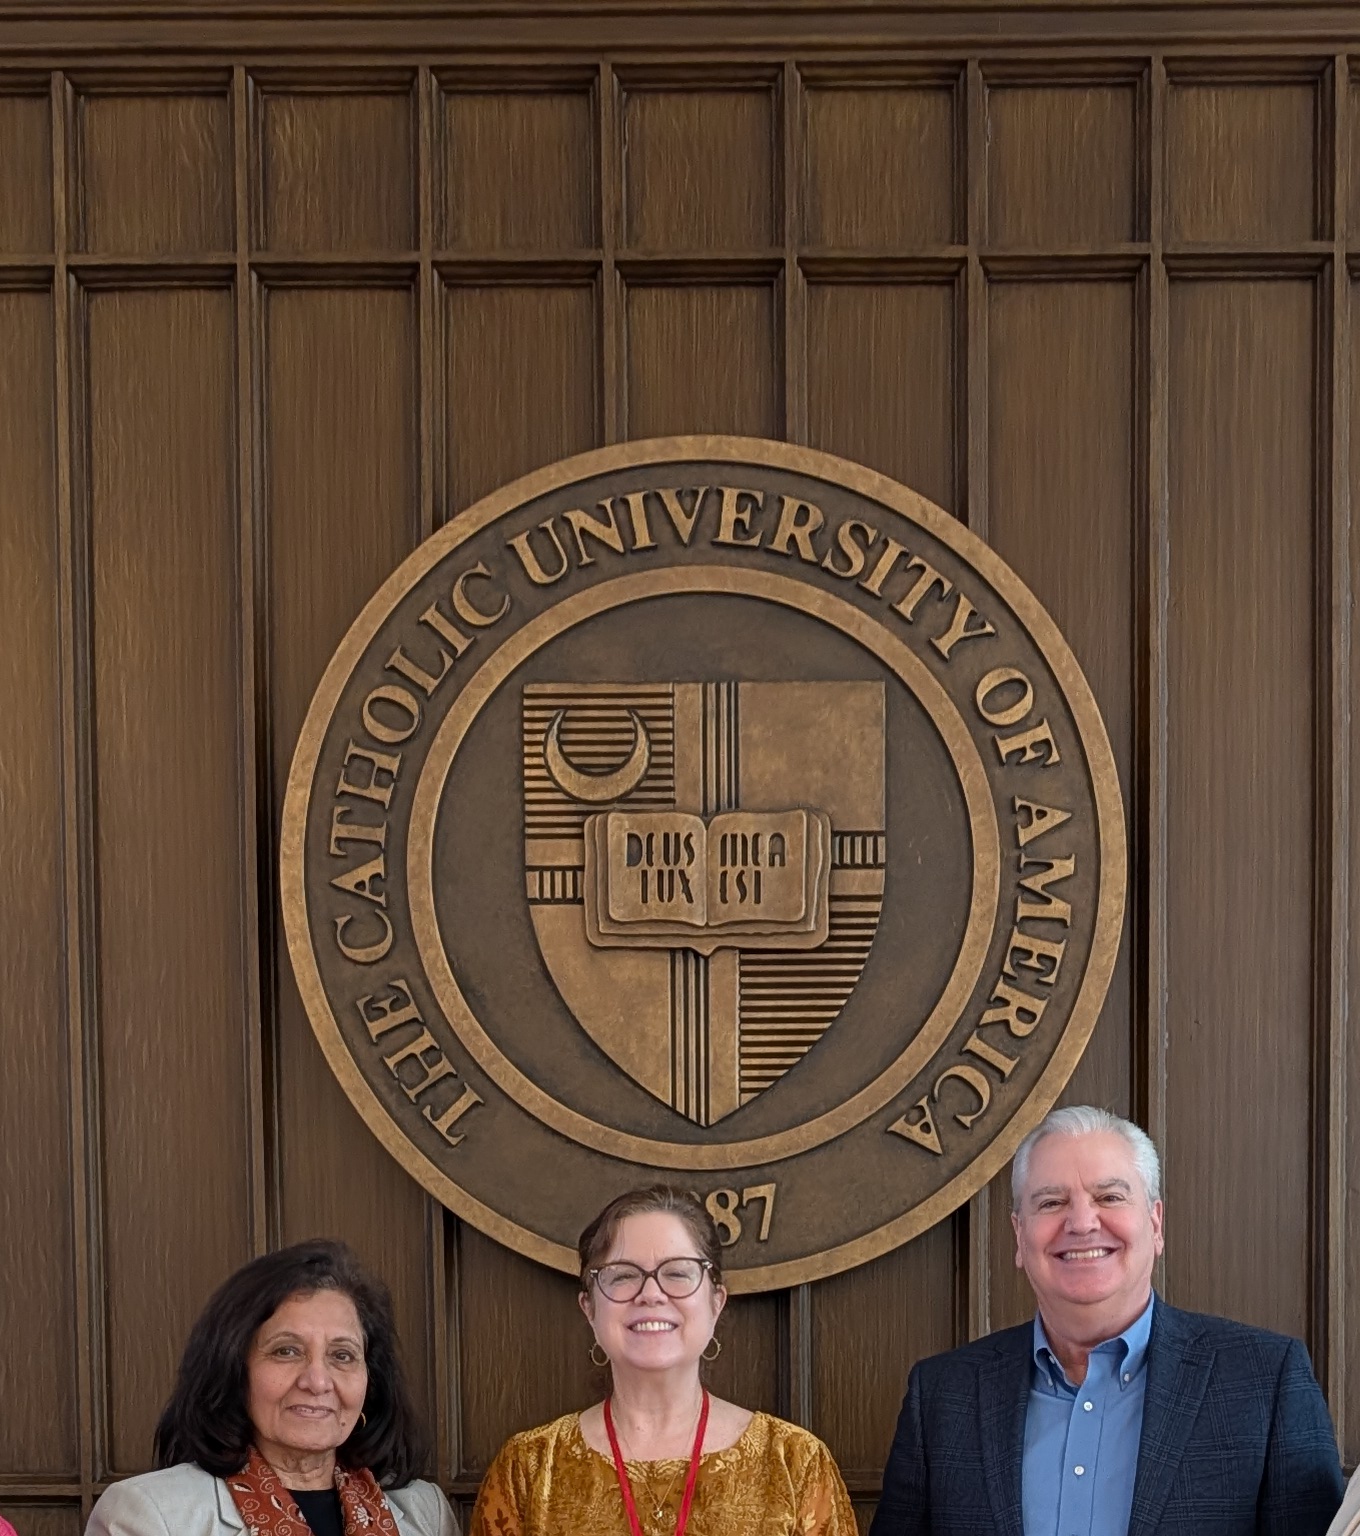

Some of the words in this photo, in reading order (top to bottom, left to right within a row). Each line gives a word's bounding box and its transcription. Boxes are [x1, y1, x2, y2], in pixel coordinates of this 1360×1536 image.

[505, 485, 998, 661] UNIVERSITY
[328, 561, 512, 964] CATHOLIC
[974, 665, 1063, 770] OF
[885, 796, 1079, 1156] AMERICA
[356, 979, 489, 1149] THE
[690, 1182, 777, 1247] 87
